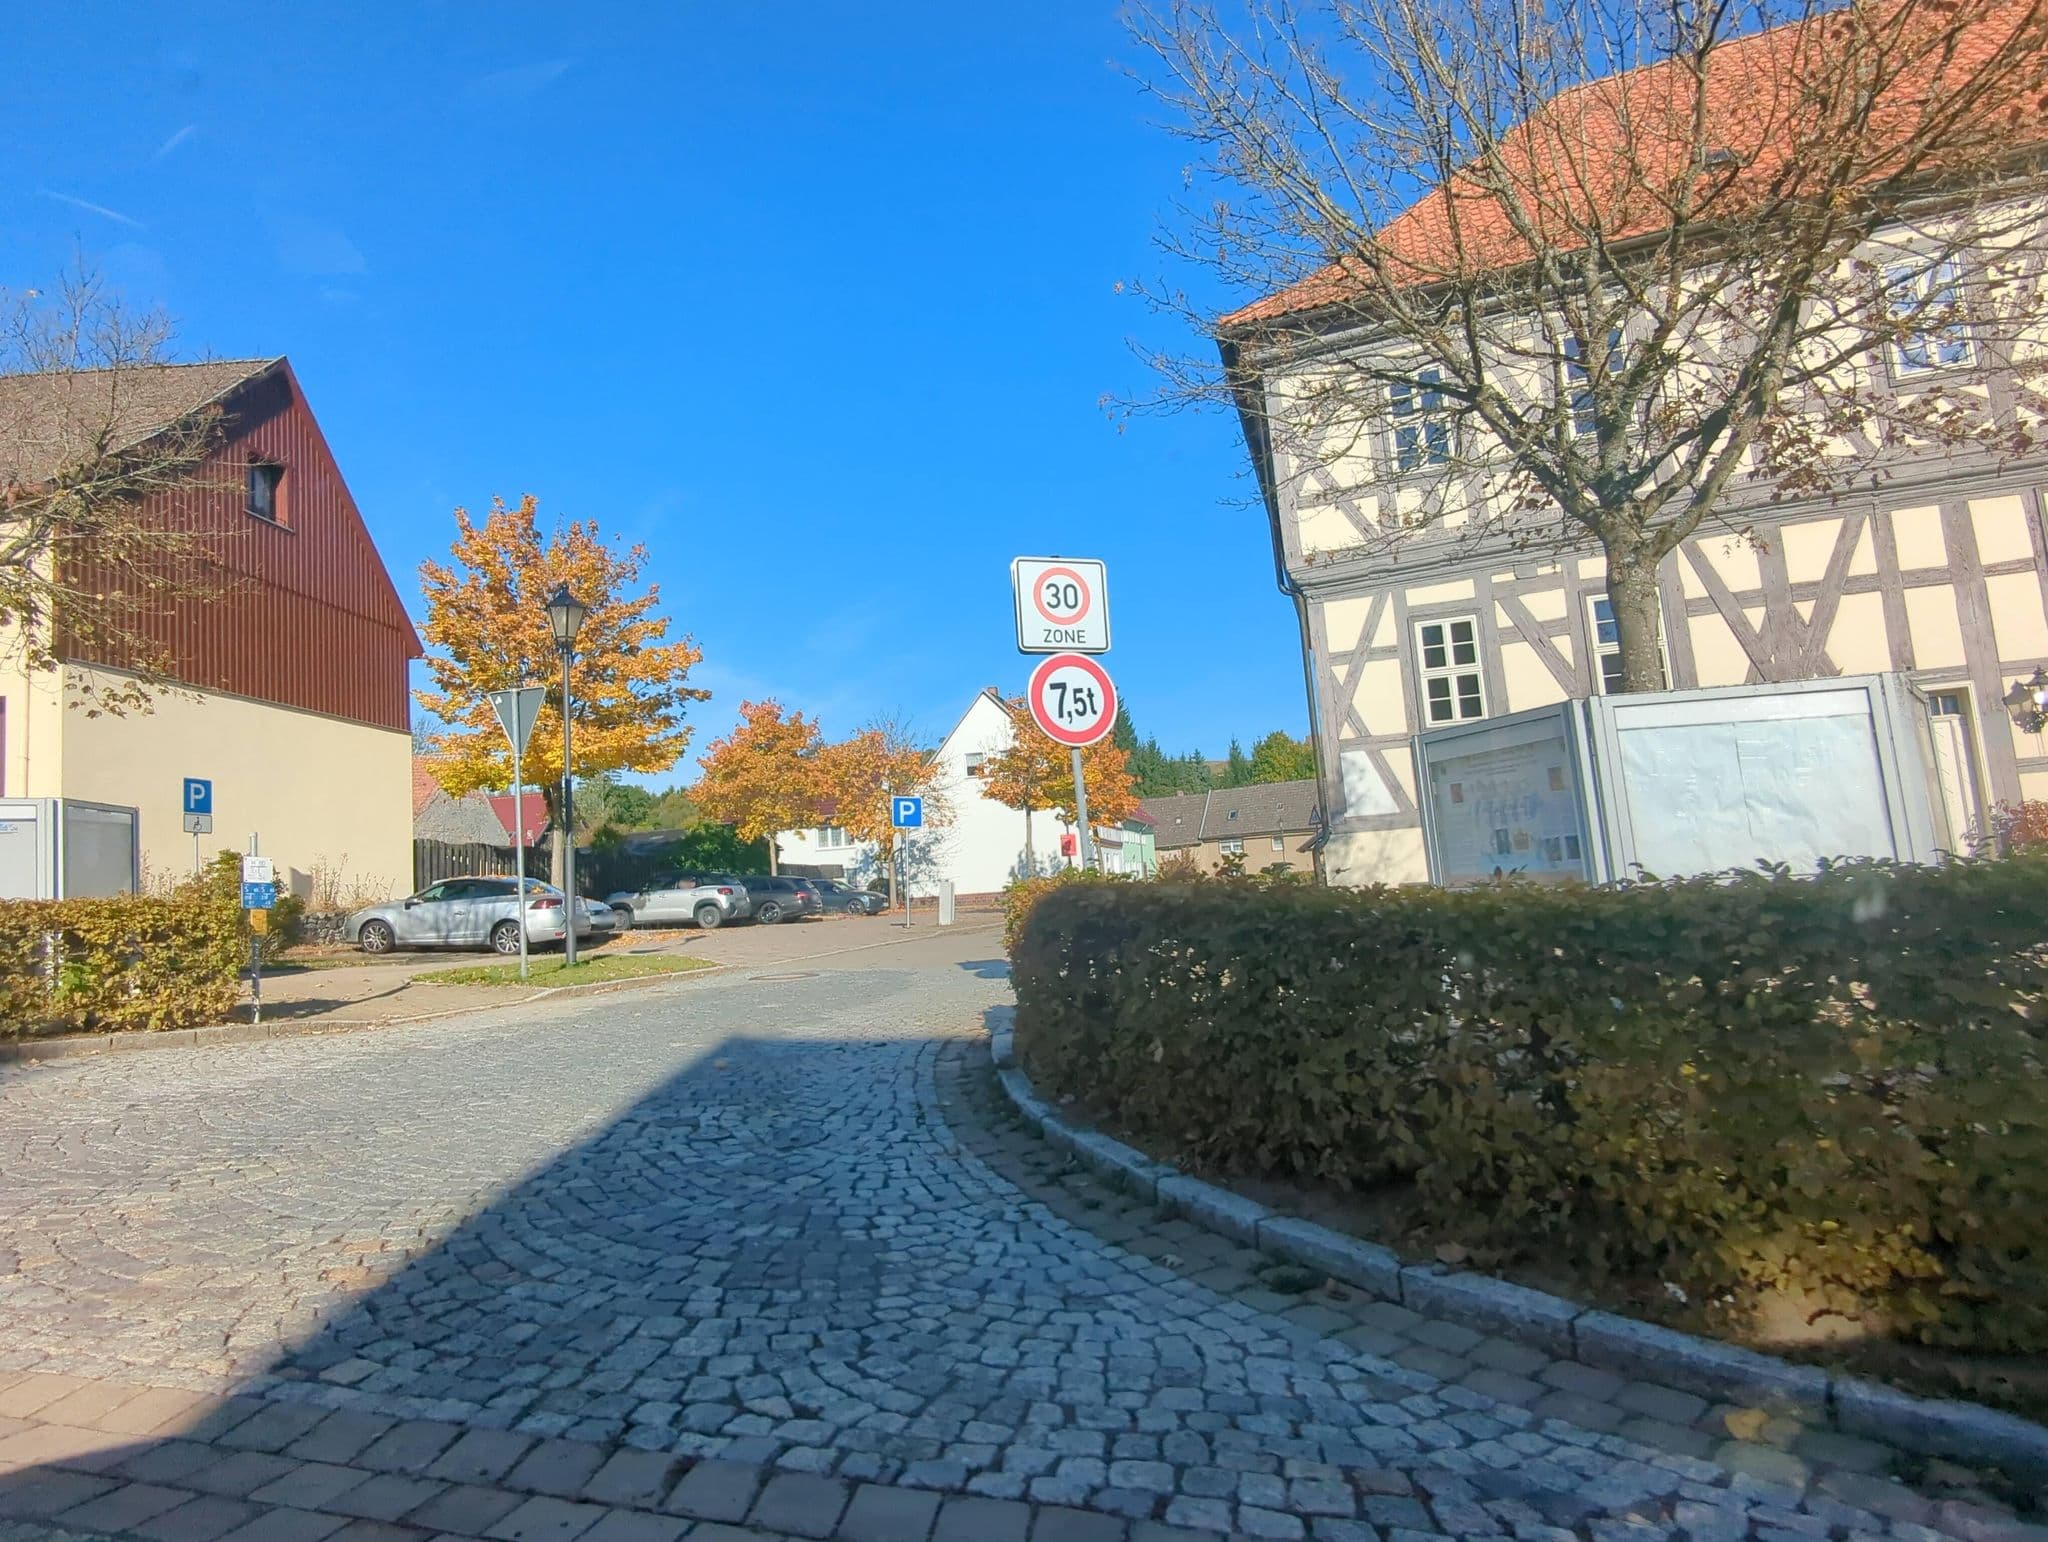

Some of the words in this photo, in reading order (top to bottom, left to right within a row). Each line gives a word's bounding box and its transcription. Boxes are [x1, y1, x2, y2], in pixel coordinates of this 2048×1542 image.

[1045, 583, 1079, 609] 30
[1043, 628, 1086, 644] ZONE
[1049, 682, 1098, 724] 7,5t
[190, 783, 205, 809] P
[899, 801, 916, 824] P
